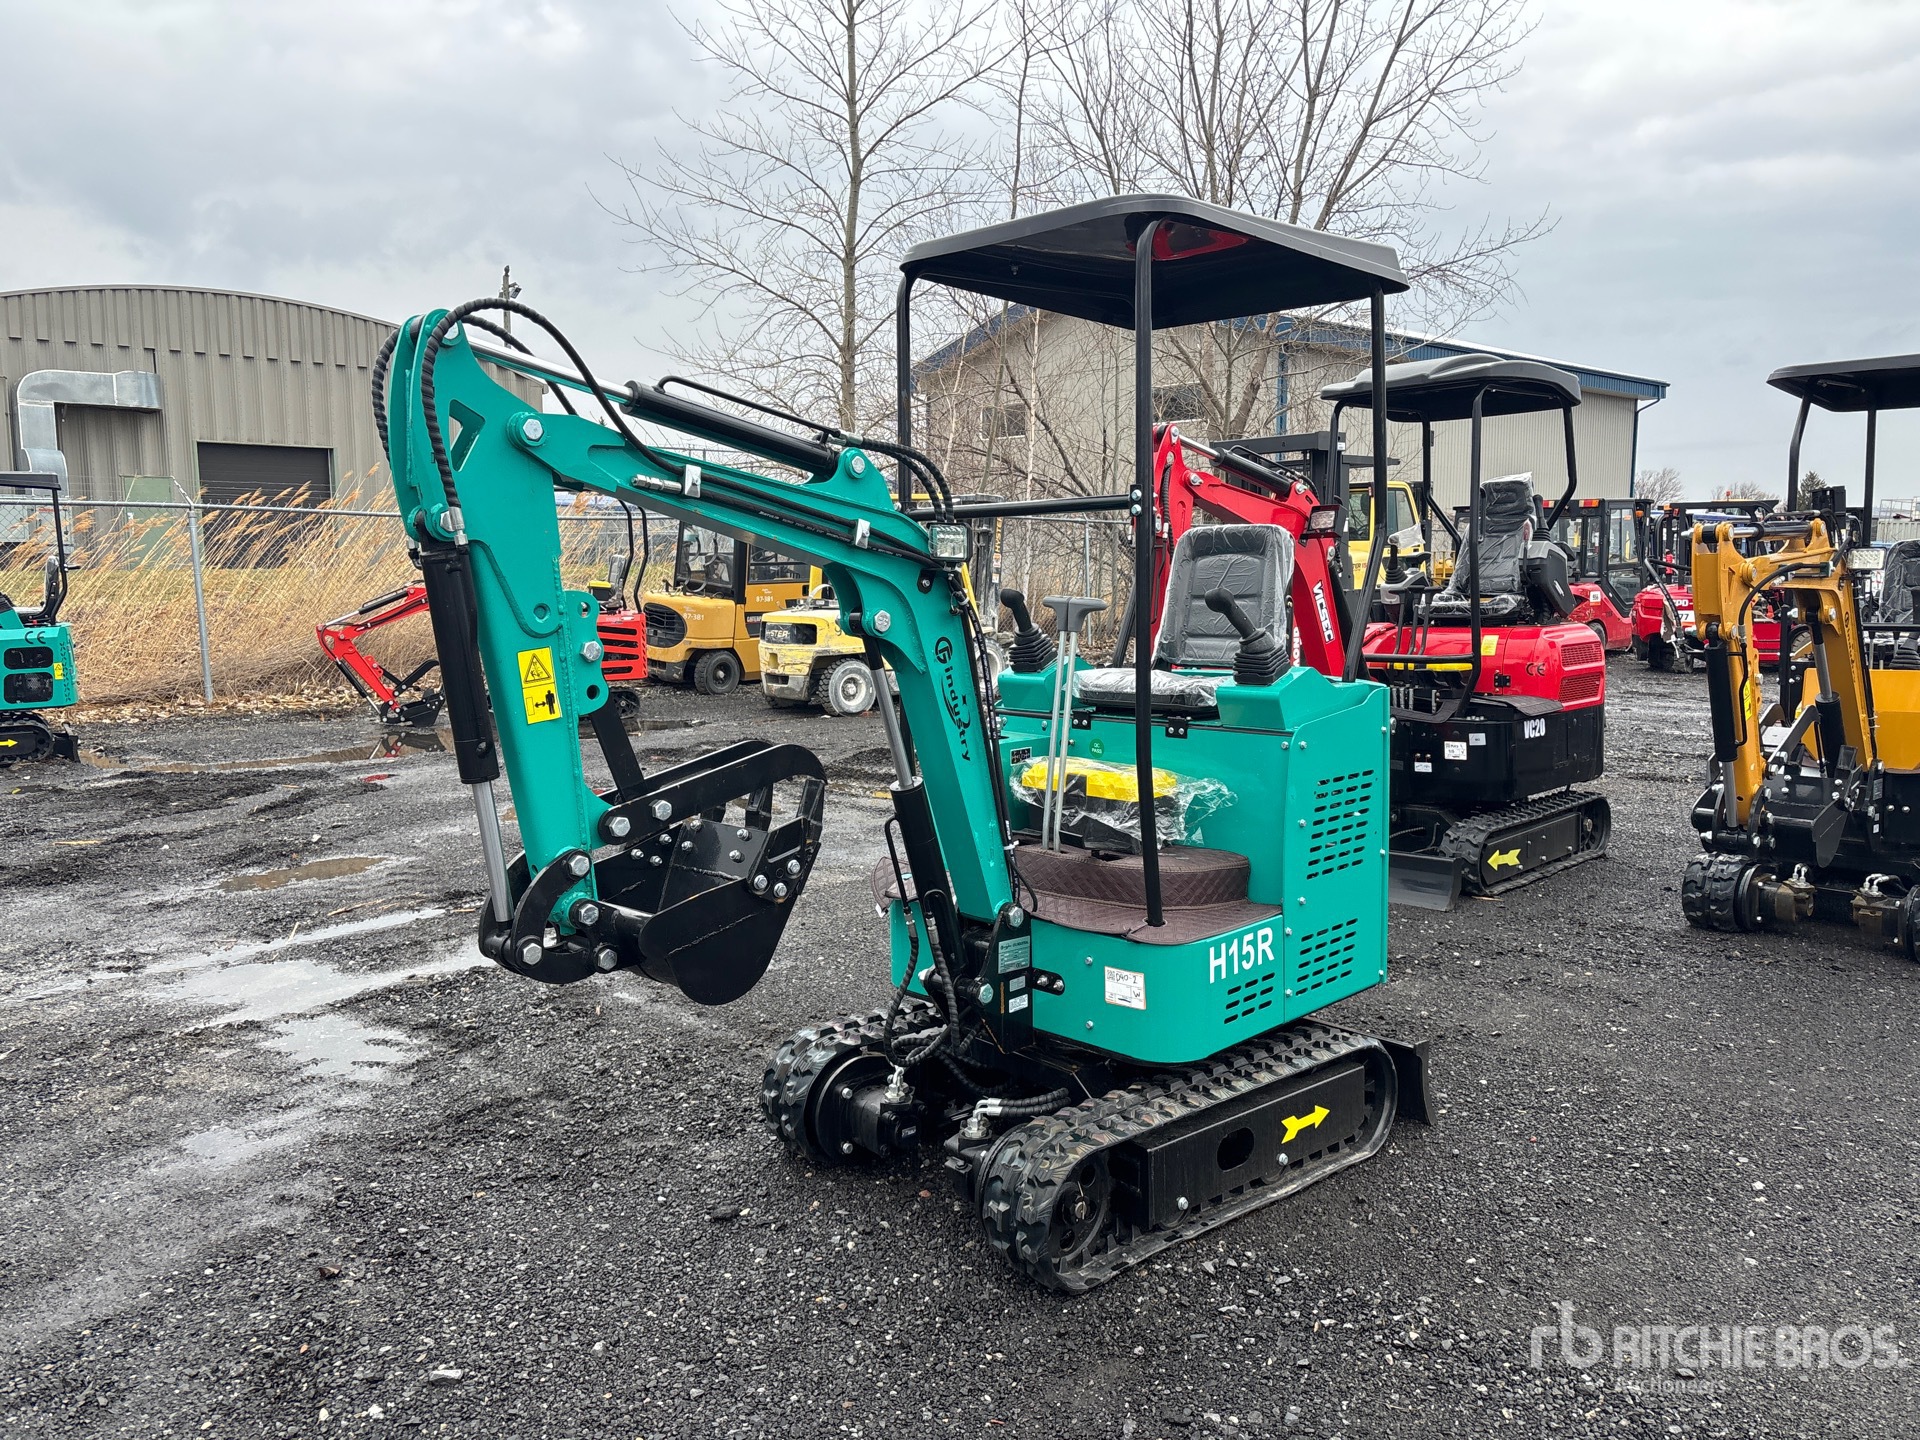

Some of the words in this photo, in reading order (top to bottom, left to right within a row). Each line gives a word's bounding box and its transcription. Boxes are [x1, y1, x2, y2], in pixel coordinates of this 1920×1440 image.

[1312, 580, 1334, 644] VICSEC
[1523, 718, 1546, 739] VC20
[1209, 927, 1275, 984] H15R
